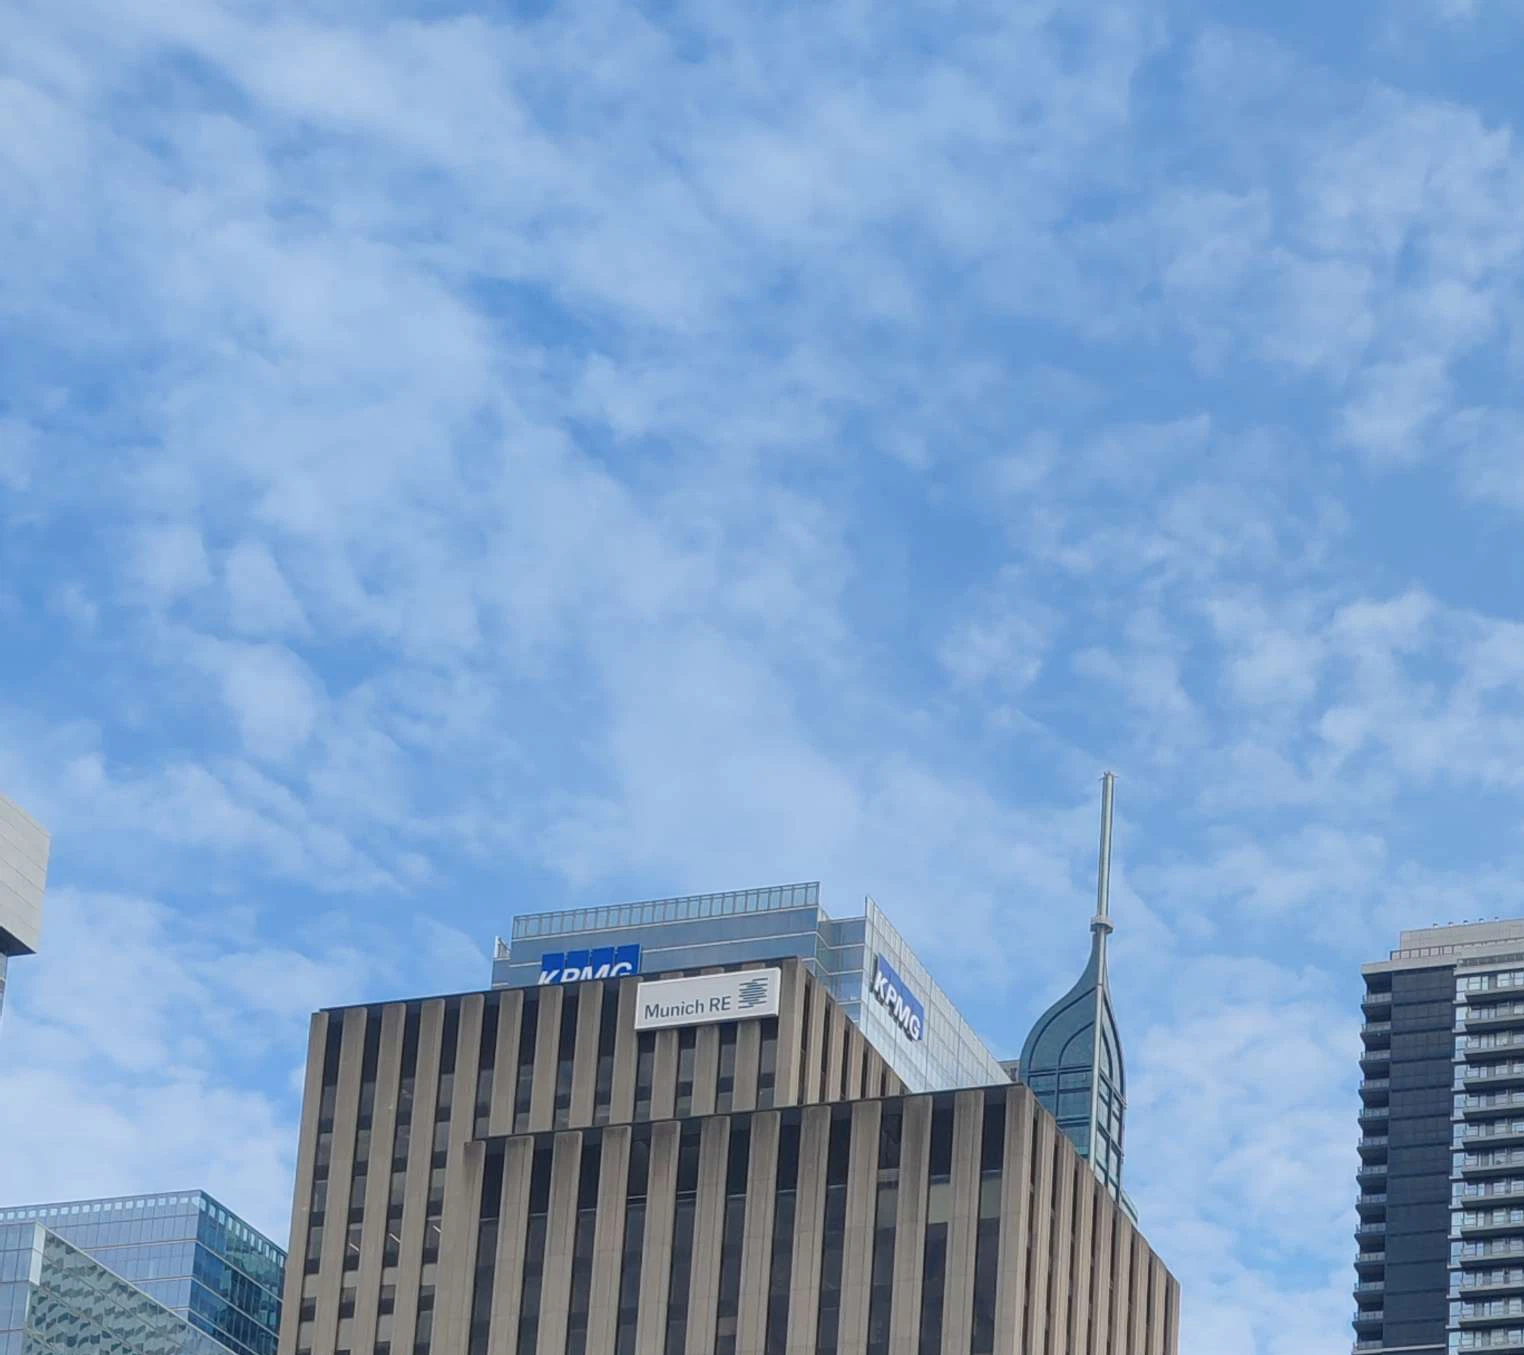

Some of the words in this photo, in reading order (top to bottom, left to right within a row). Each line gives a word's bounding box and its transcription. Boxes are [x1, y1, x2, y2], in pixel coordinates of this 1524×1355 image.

[644, 1001, 705, 1020] Munich
[709, 995, 732, 1012] RE
[874, 971, 921, 1041] KPMG
